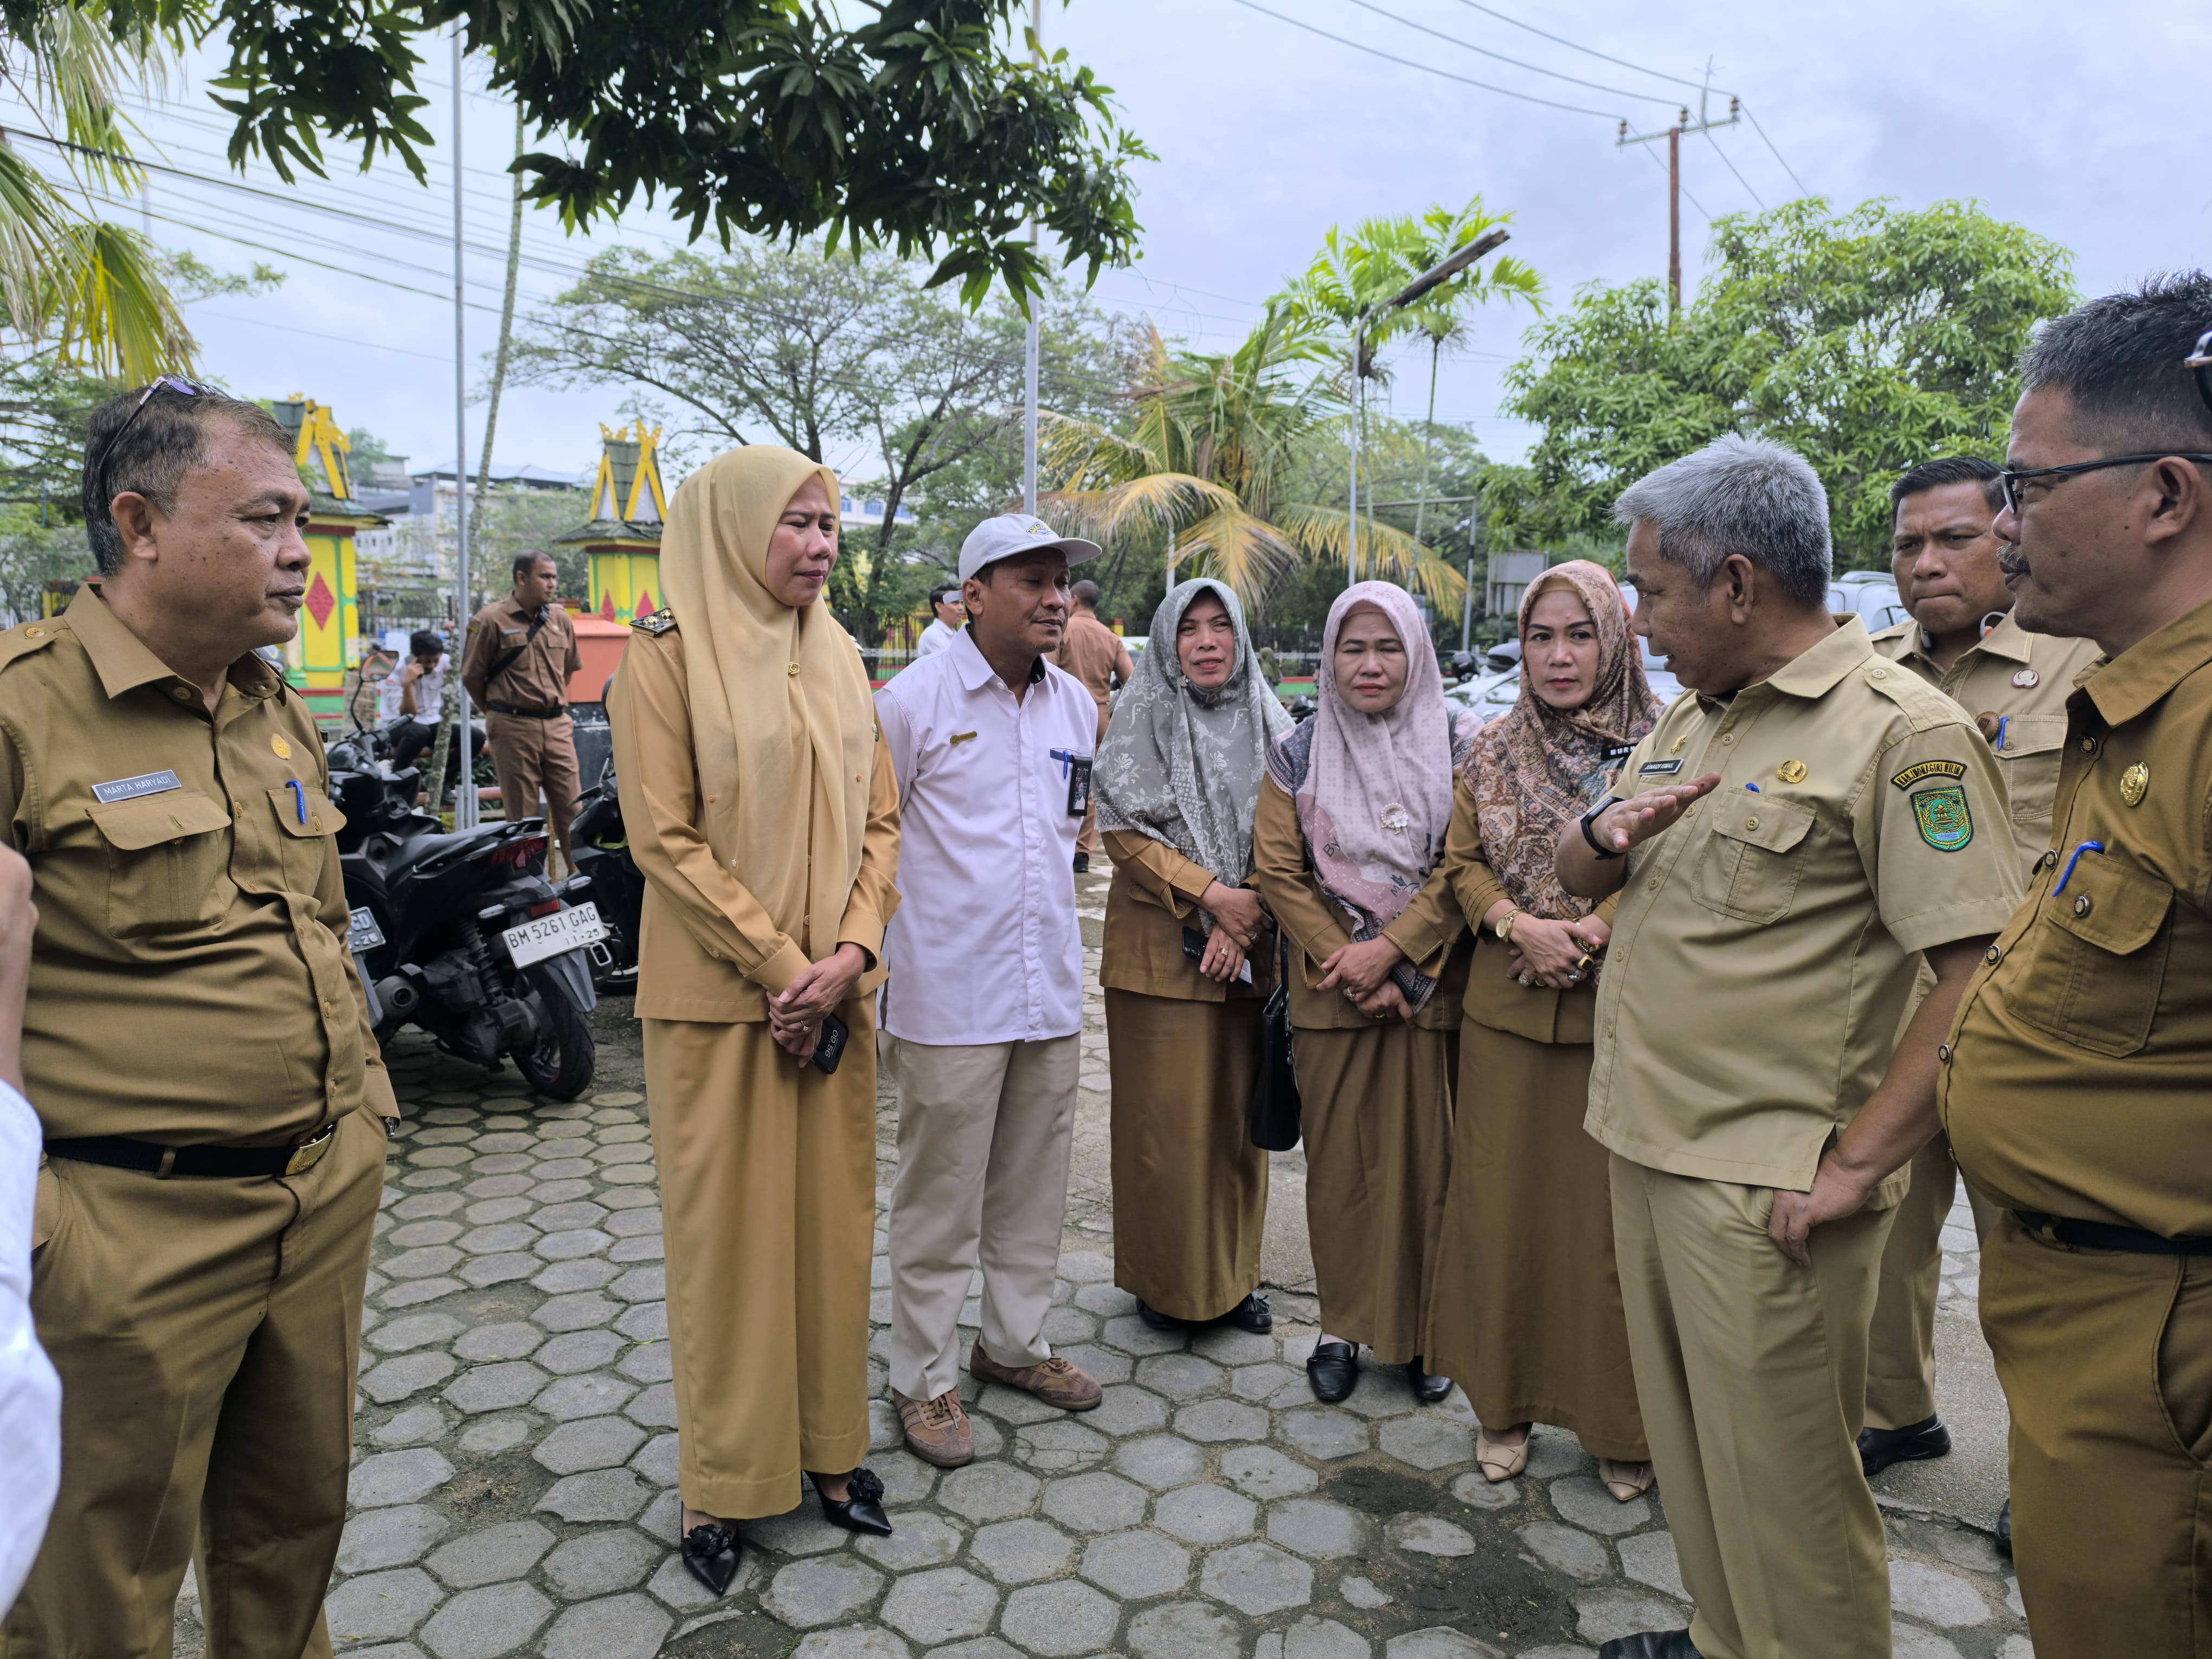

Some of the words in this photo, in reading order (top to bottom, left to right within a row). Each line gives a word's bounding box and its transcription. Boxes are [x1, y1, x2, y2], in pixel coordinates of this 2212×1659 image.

[103, 783, 134, 796] MARTA
[136, 776, 172, 790] HARYADI
[508, 929, 531, 948] BM
[531, 917, 566, 939] 5261
[569, 907, 596, 927] GAG
